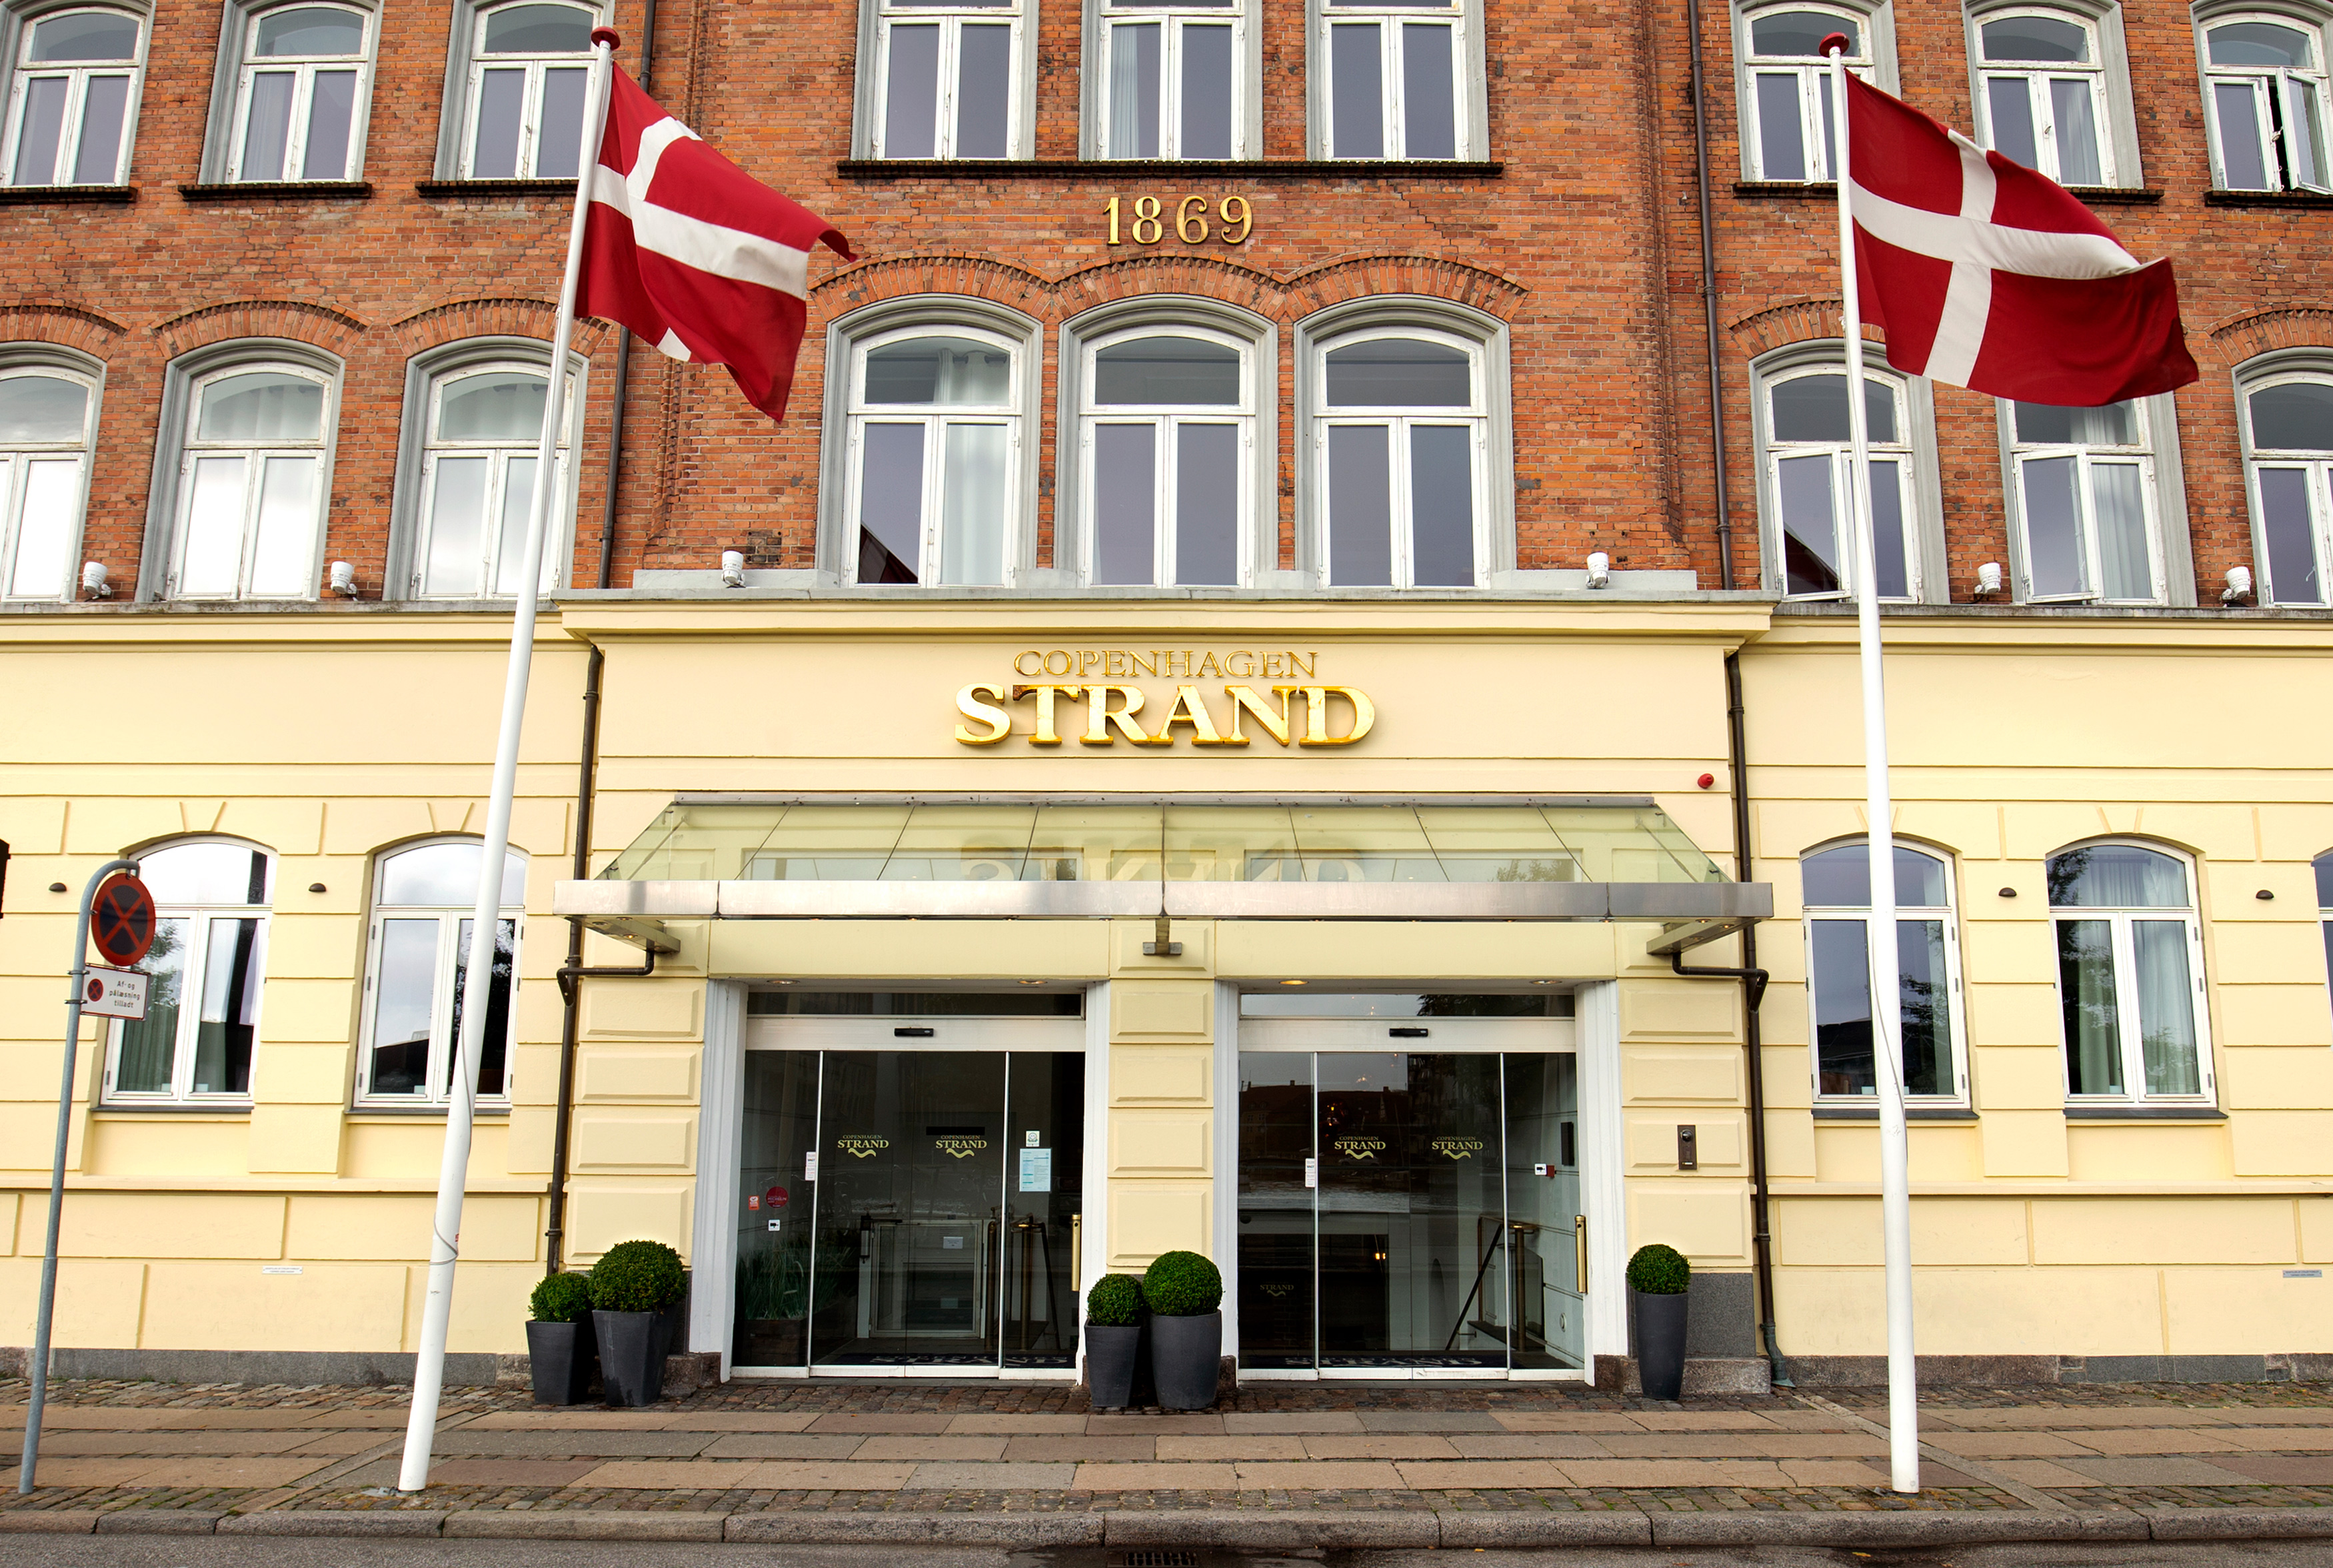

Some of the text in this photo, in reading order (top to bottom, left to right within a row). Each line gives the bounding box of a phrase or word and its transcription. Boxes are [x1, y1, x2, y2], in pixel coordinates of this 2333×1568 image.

[1103, 195, 1252, 245] 1869
[1013, 650, 1318, 678] COPENHAGEN
[955, 682, 1376, 746] STRAND
[109, 990, 140, 1000] pålæsning
[837, 1140, 889, 1148] STRAND
[936, 1140, 987, 1148] STRAND
[1334, 1141, 1386, 1150] STRAND
[1432, 1141, 1483, 1150] STRAND
